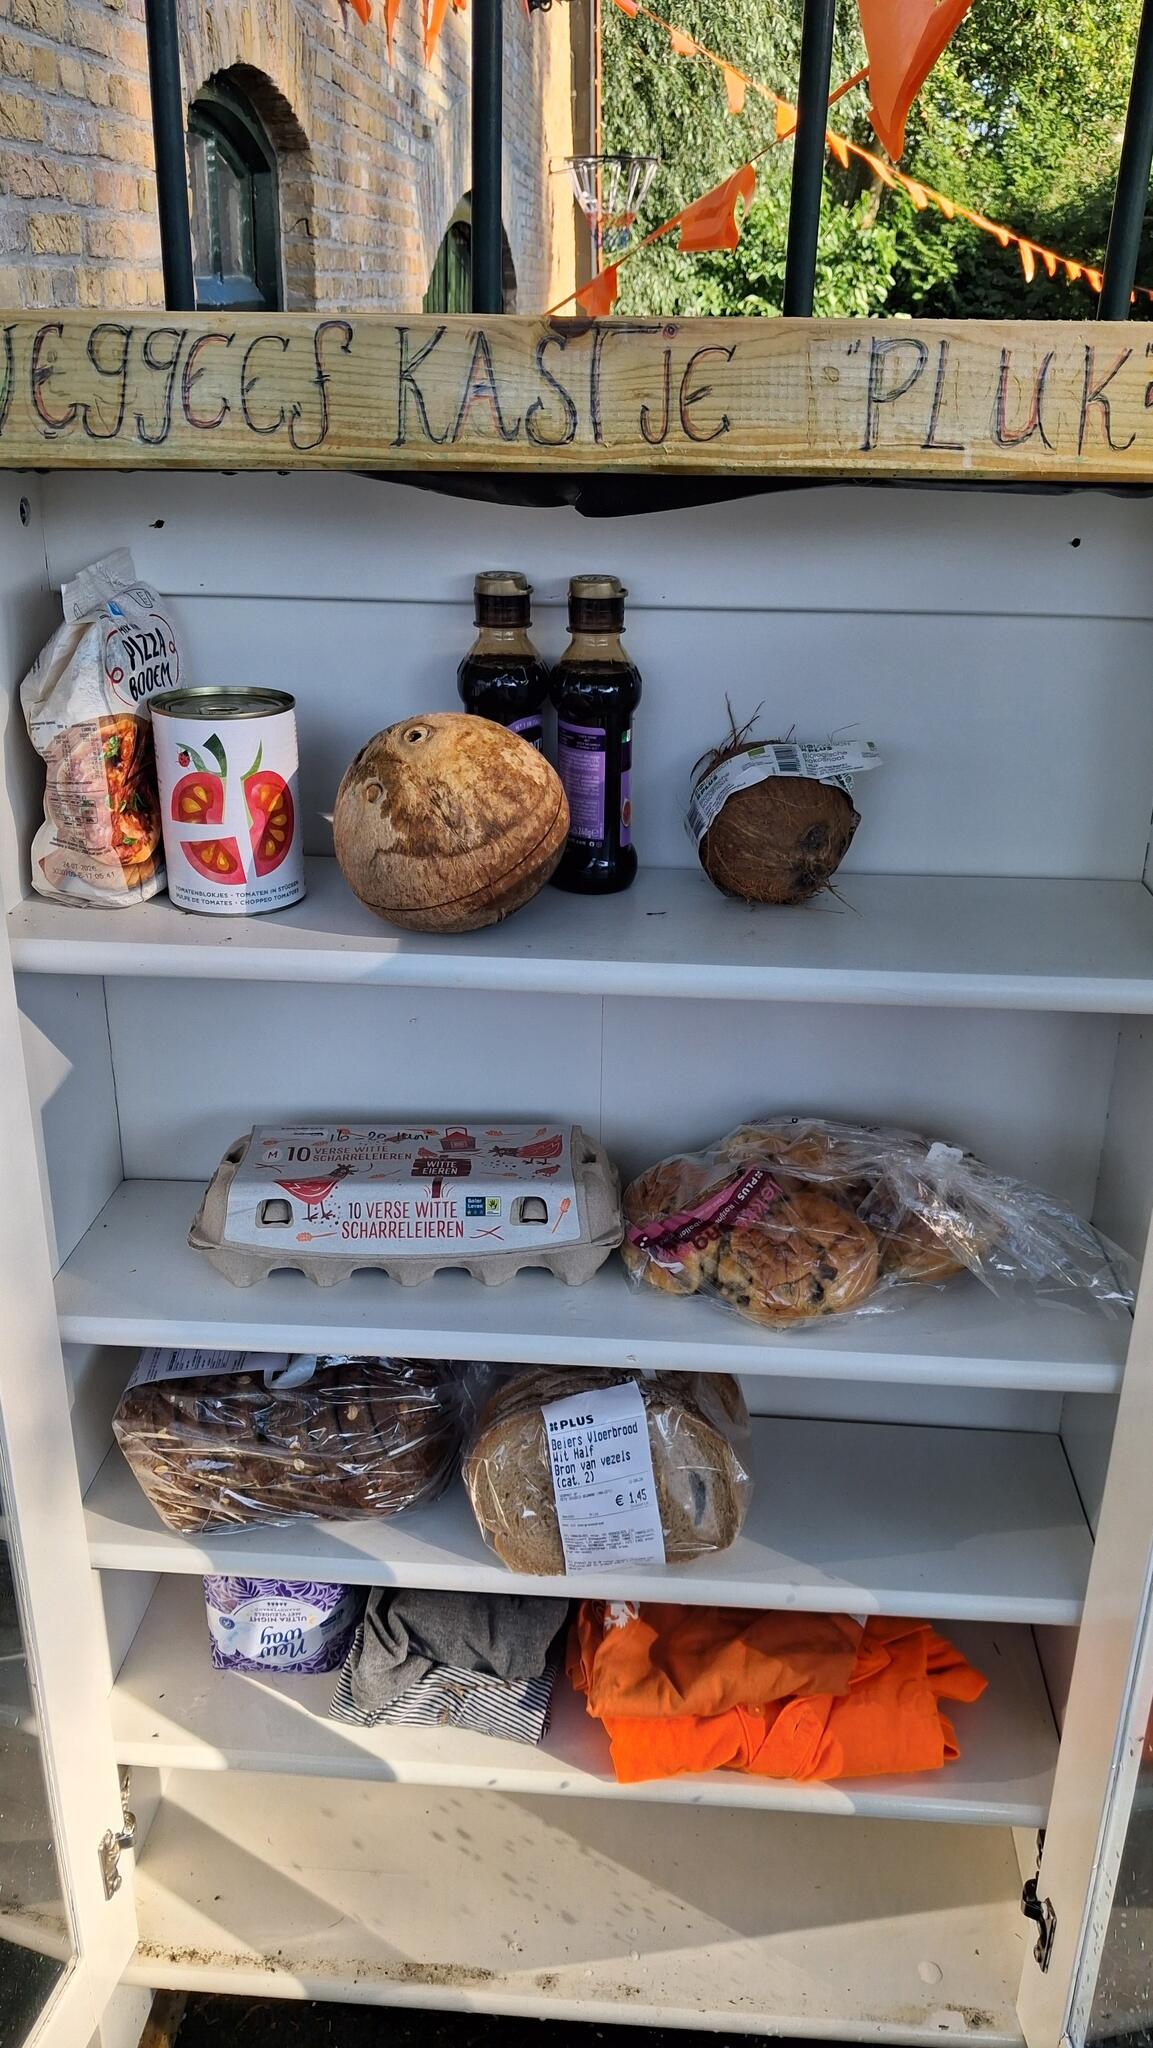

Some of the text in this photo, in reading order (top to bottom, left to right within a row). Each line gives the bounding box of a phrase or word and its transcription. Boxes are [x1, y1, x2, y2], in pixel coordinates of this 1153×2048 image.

[122, 627, 167, 671] PIZZA
[129, 662, 173, 702] BODEM
[175, 885, 228, 898] TOMATENBLOKJES
[235, 889, 268, 898] TOMATEN
[240, 896, 273, 906] CHOPPED
[274, 887, 300, 900] TOMATOES
[268, 1150, 278, 1160] M
[287, 1146, 312, 1162] 10
[312, 1145, 389, 1155] VERSE WITTE
[312, 1152, 412, 1162] SCHARRELEIEREN
[422, 1167, 458, 1176] EIEREN
[427, 1160, 457, 1168] WITTE
[738, 1176, 759, 1202] PLUS
[348, 1201, 458, 1220] 10 VERSE WITTE
[342, 1220, 464, 1239] SCHARRELEIEREN
[560, 1415, 594, 1430] PLUS
[551, 1422, 638, 1450] Beiers Vloerbrood
[553, 1445, 594, 1463] Wit Half
[554, 1450, 631, 1476] Bron van vezels
[557, 1470, 594, 1488] (cat. 2)
[616, 1494, 624, 1506] €
[629, 1488, 647, 1504] 1,45
